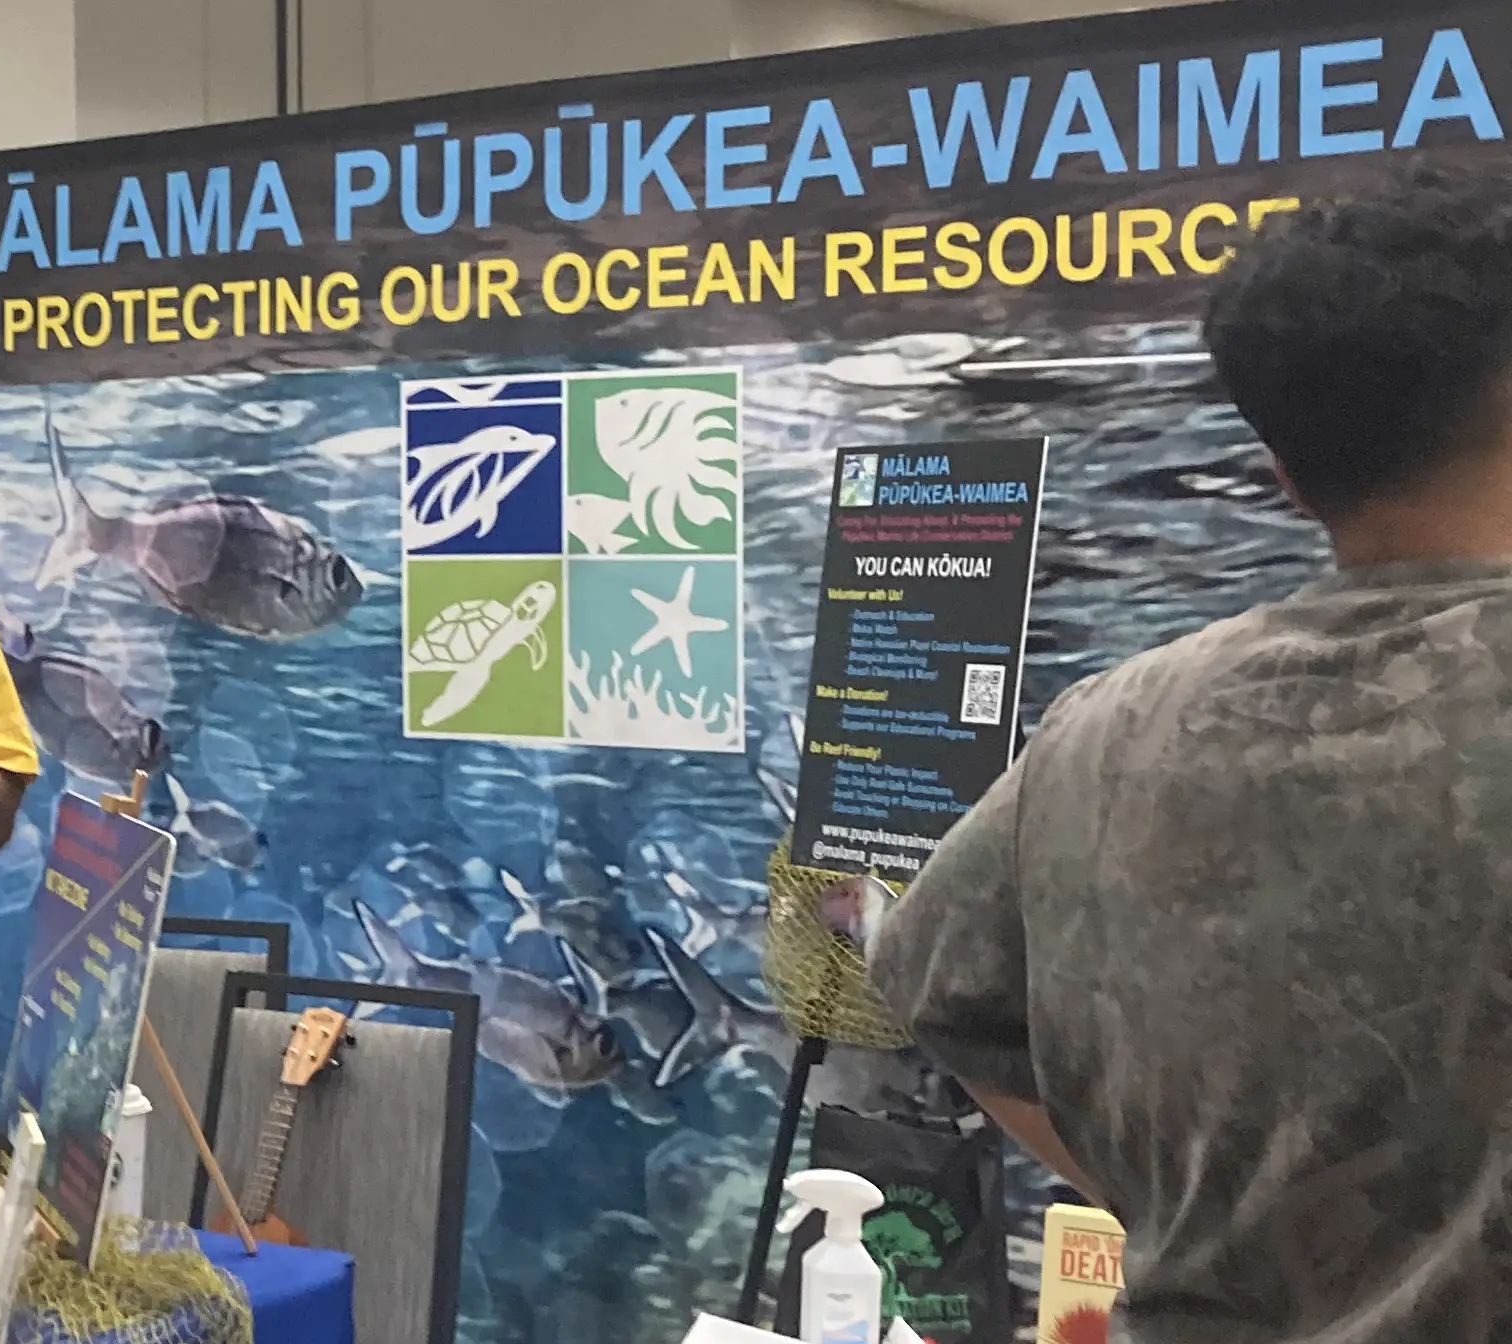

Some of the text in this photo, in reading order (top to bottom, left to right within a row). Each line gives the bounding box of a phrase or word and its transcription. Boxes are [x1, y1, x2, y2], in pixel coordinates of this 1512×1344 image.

[334, 27, 1505, 242] PŪPŪKEA-WAIMEA
[2, 197, 1301, 353] PROTECTING OUR OCEAN RESOURC
[881, 453, 951, 478] MĀLAMA
[878, 481, 1029, 506] PŪPŪKEA-WAIMEA
[854, 552, 992, 579] YOU CAN KŌKUA!
[820, 823, 943, 851] www.pupukeawaime
[1061, 1231, 1101, 1253] RAPID
[1059, 1248, 1122, 1284] DEAT
